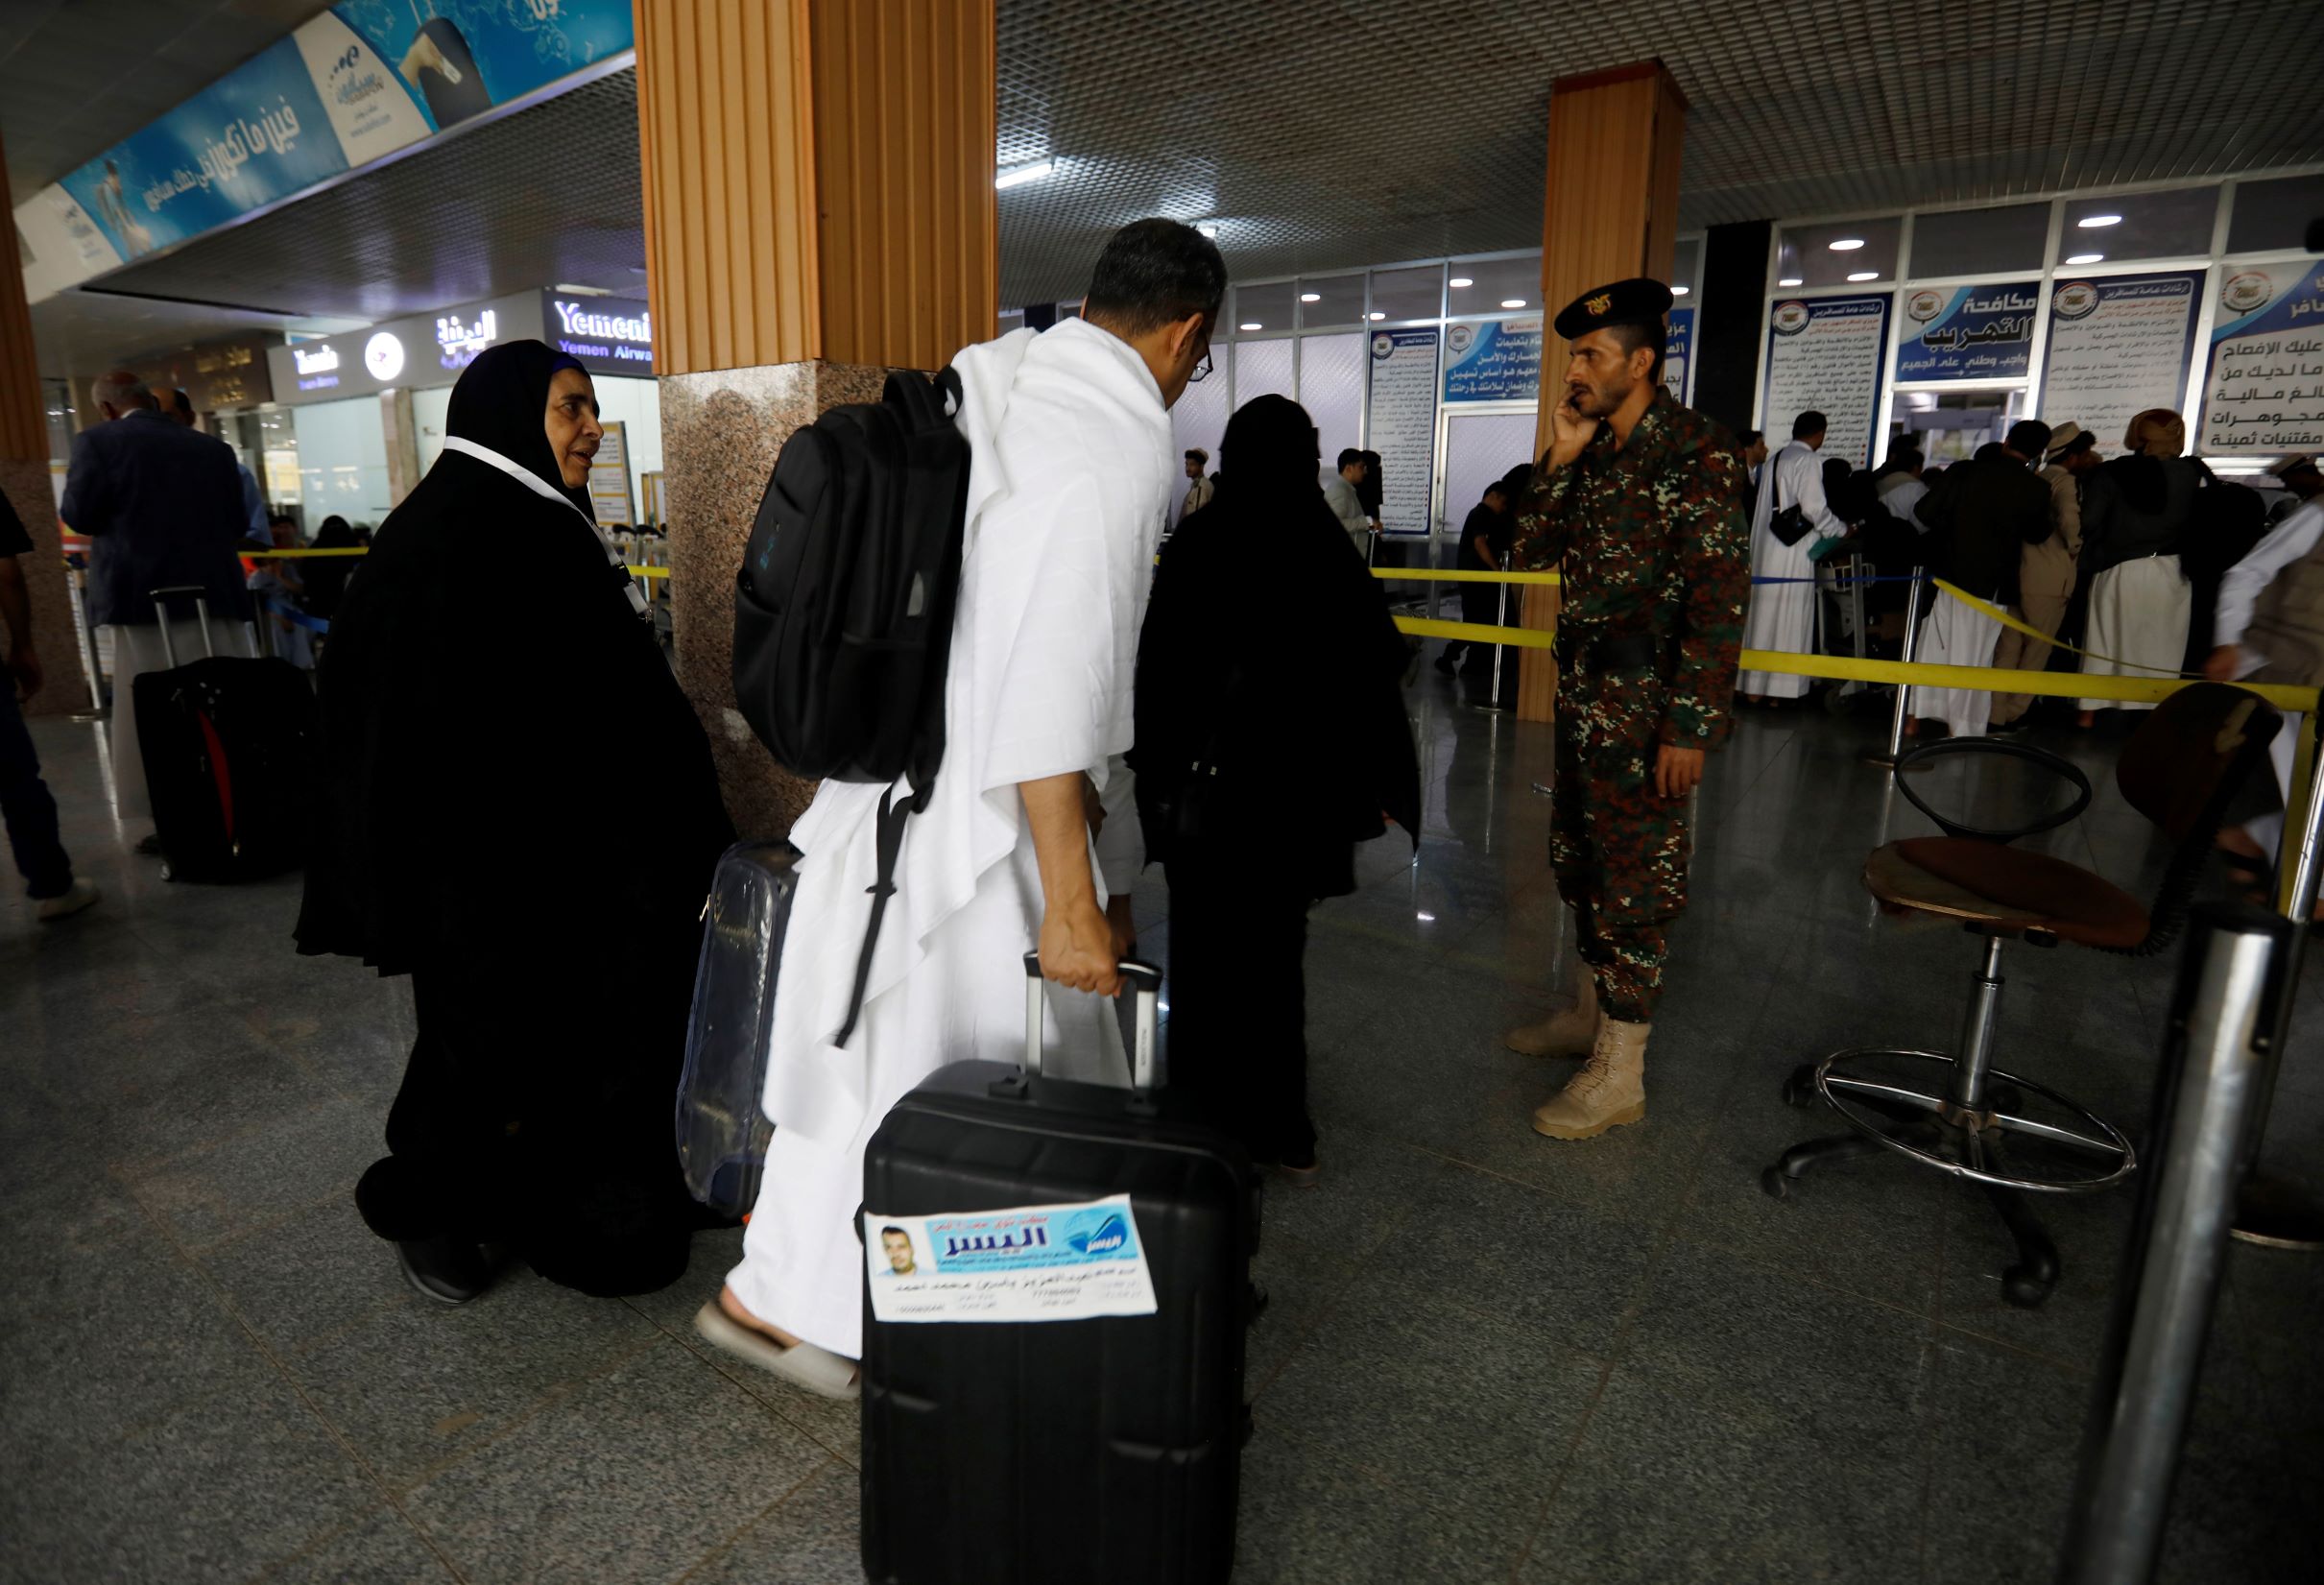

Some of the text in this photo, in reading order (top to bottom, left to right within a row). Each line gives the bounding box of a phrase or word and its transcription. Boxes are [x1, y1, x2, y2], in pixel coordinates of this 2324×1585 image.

[1963, 293, 2037, 314] مكافحة
[555, 300, 652, 343] Yemeni
[1921, 315, 2036, 353] التهريب
[559, 340, 653, 361] Yemen Airwa
[1507, 350, 1542, 363] لجمارك
[2222, 340, 2323, 361] عليك الإفصاح
[1901, 352, 2028, 371] واجب وطني على الجميع
[1450, 367, 1478, 380] تسهيل
[2220, 367, 2243, 381] من
[2247, 364, 2296, 380] لديك
[2216, 386, 2324, 404] الغ مالية
[2211, 411, 2324, 427] مجوهرات
[2211, 431, 2323, 448] مقتنيات ثمينة
[946, 1226, 1047, 1257] اليسر
